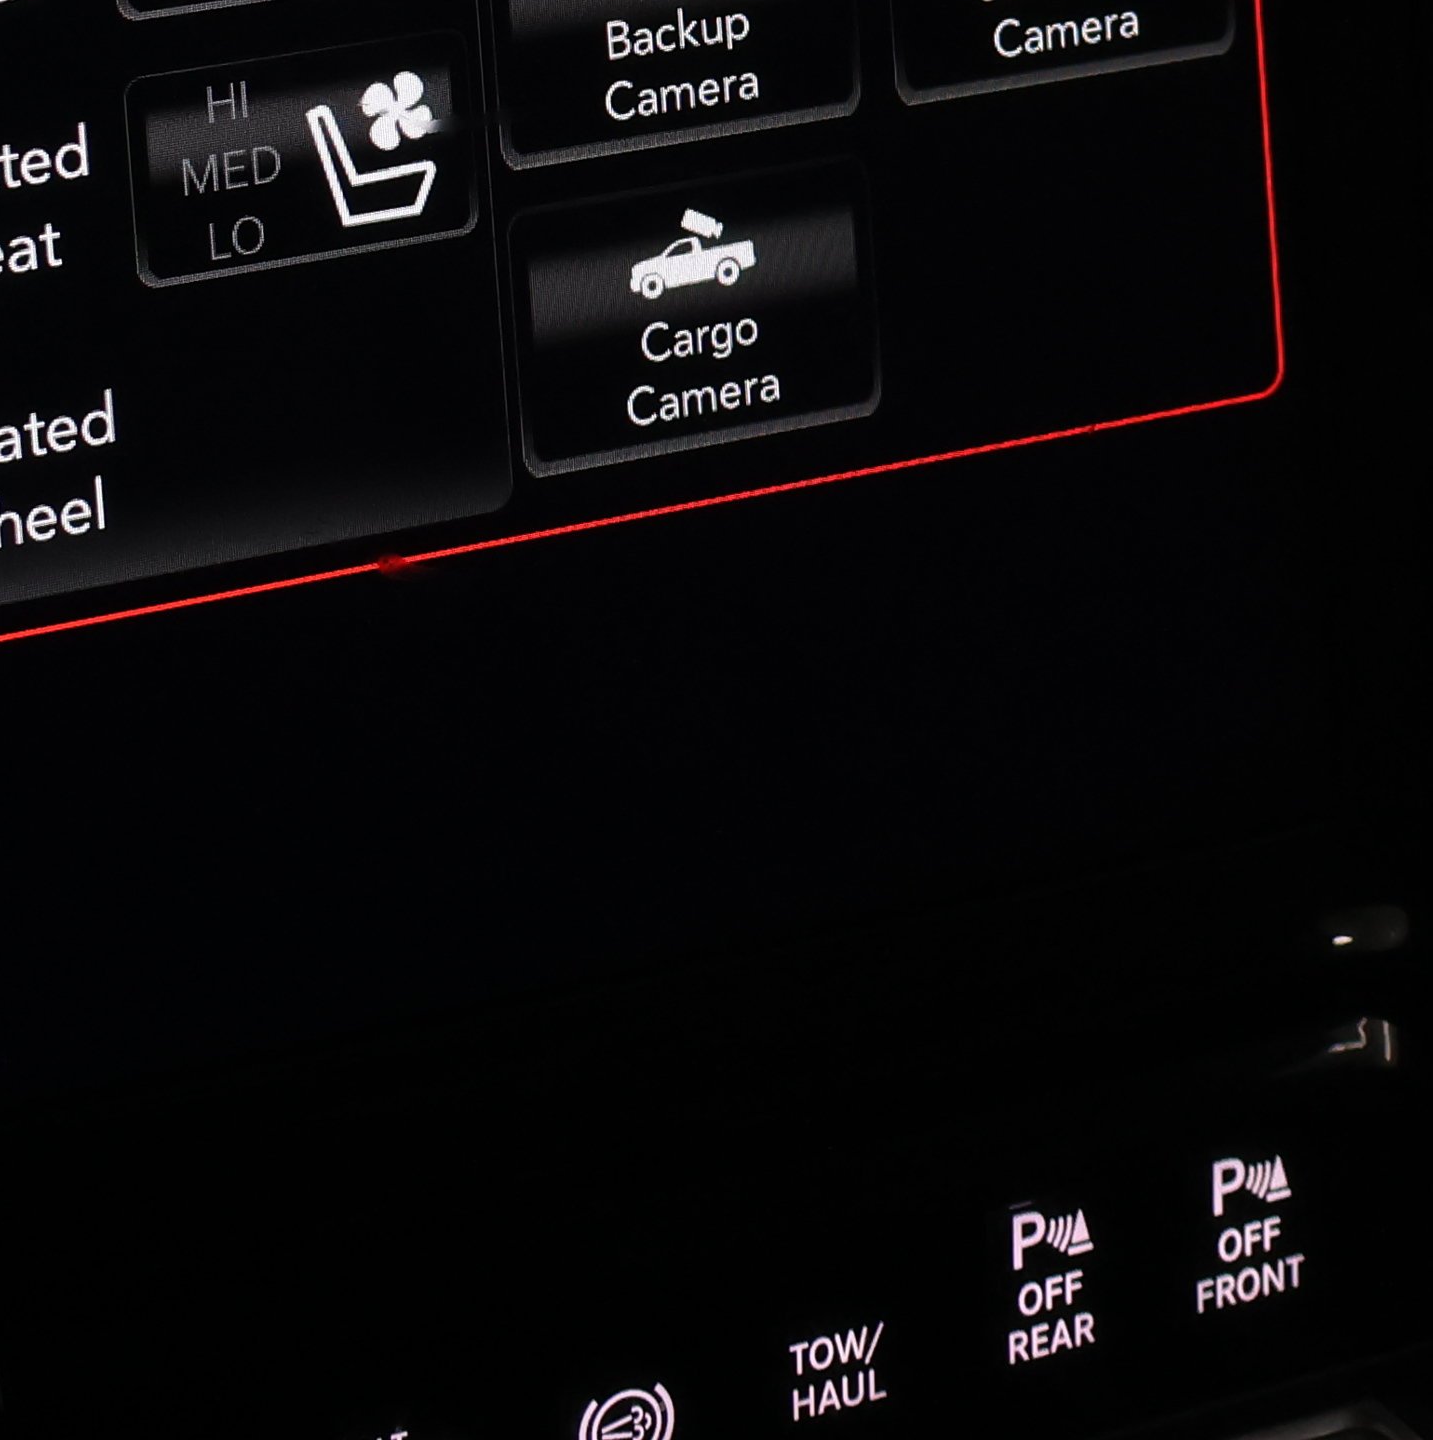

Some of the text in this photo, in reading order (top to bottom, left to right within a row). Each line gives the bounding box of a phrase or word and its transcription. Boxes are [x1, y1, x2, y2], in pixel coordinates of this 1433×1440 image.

[607, 8, 749, 60] Backup
[994, 11, 1139, 57] Camera
[205, 81, 249, 126] HI
[605, 73, 759, 120] Camera
[180, 145, 283, 198] MED
[209, 216, 265, 260] LO
[641, 318, 758, 362] Cargo
[627, 375, 780, 426] Camera
[1218, 1216, 1281, 1262] OFF
[1018, 1270, 1083, 1316] OFF
[1197, 1254, 1304, 1313] FRONT
[789, 1322, 884, 1375] TOW/
[1009, 1312, 1095, 1364] REAR
[793, 1369, 886, 1421] HAUL
